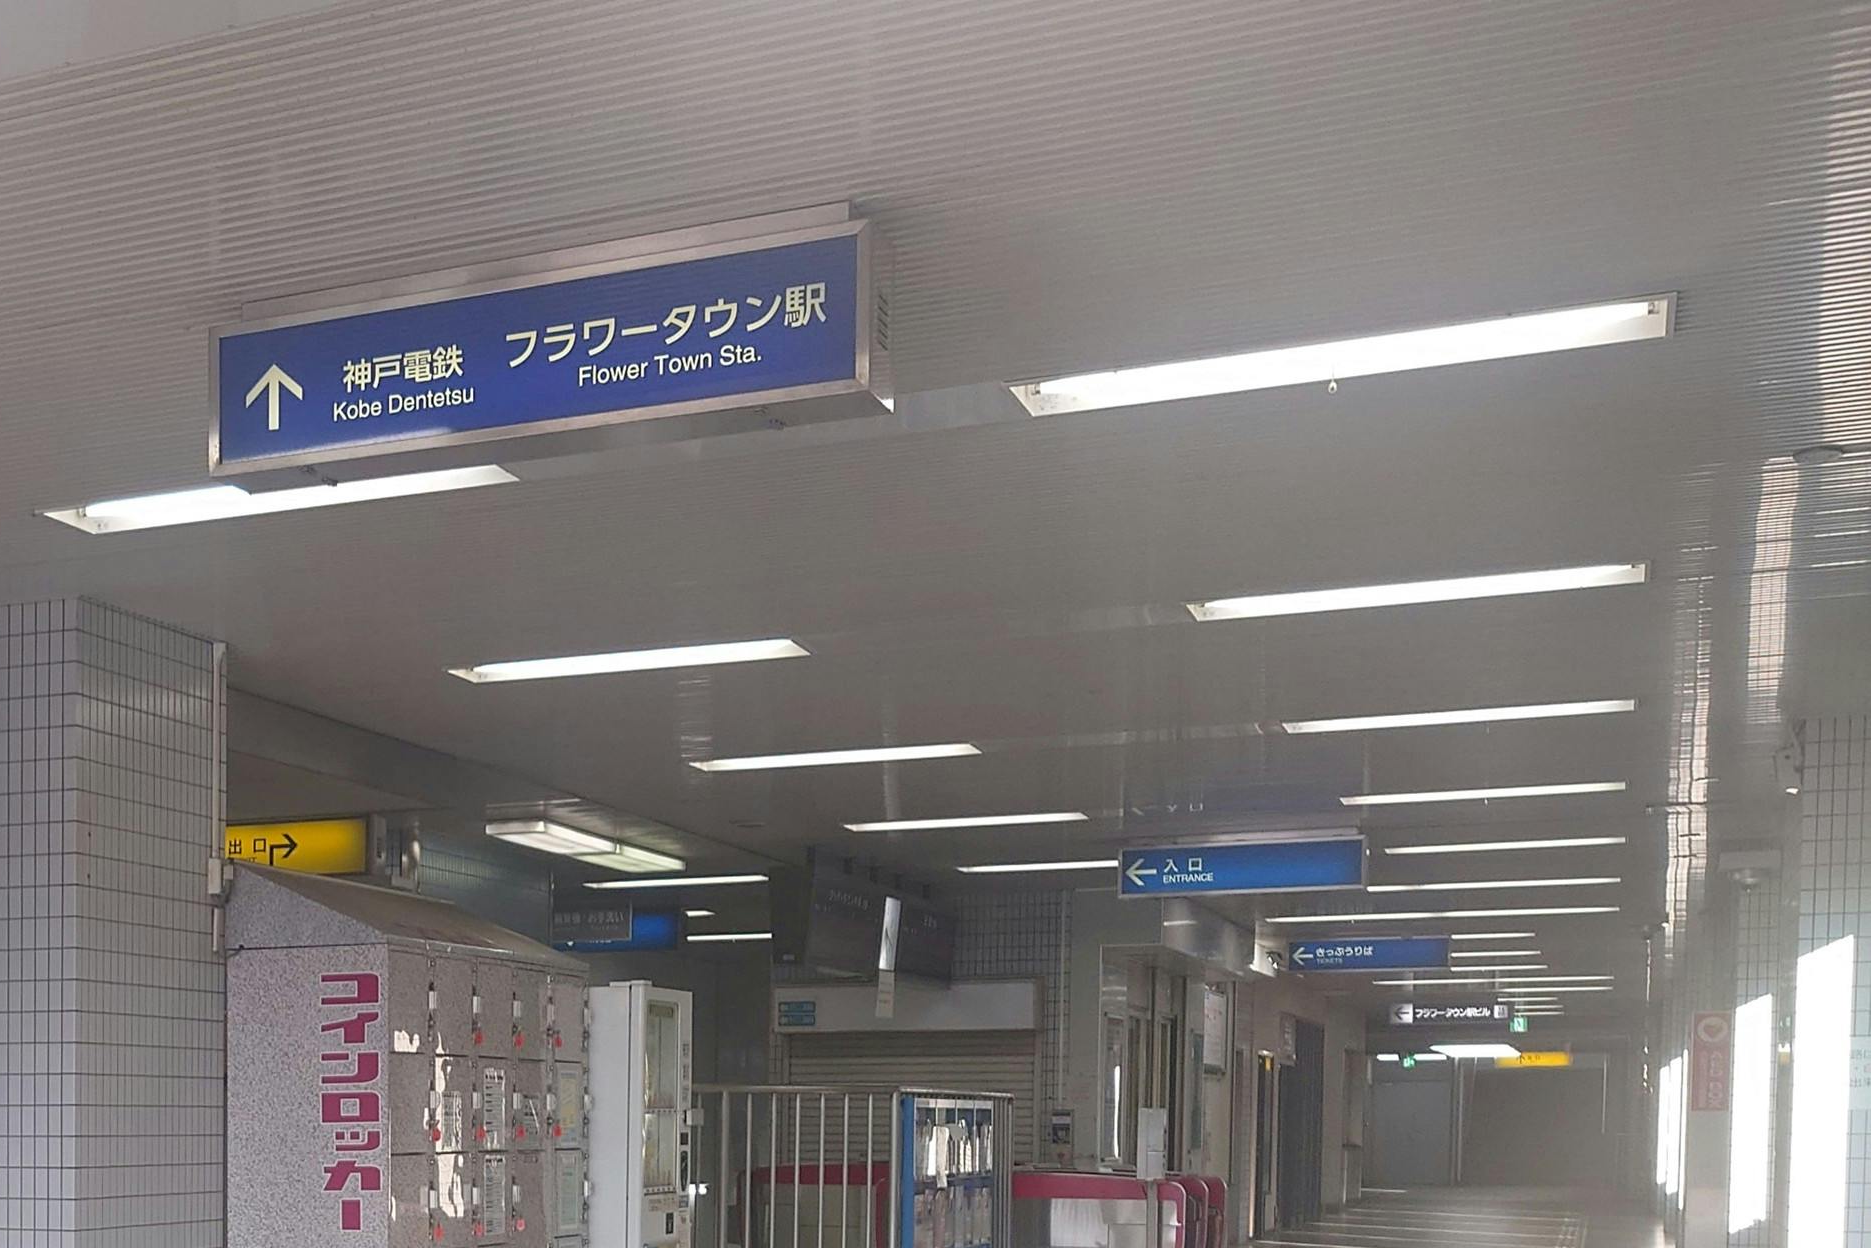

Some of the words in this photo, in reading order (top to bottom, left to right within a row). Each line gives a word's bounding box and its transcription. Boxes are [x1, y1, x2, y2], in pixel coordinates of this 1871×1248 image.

[506, 282, 826, 368] フラワータウン駅
[342, 344, 464, 393] 神戸電鉄
[578, 361, 649, 387] Flower
[654, 351, 713, 375] Town
[719, 344, 762, 366] Sta.
[333, 399, 383, 422] Kobe
[388, 387, 475, 414] Dentetsu
[228, 838, 267, 855] 出口
[1163, 857, 1203, 873] 入口
[1163, 872, 1214, 884] ENTRANCE
[1315, 945, 1374, 957] きっぷうりば
[321, 972, 382, 1231] コインロッカー
